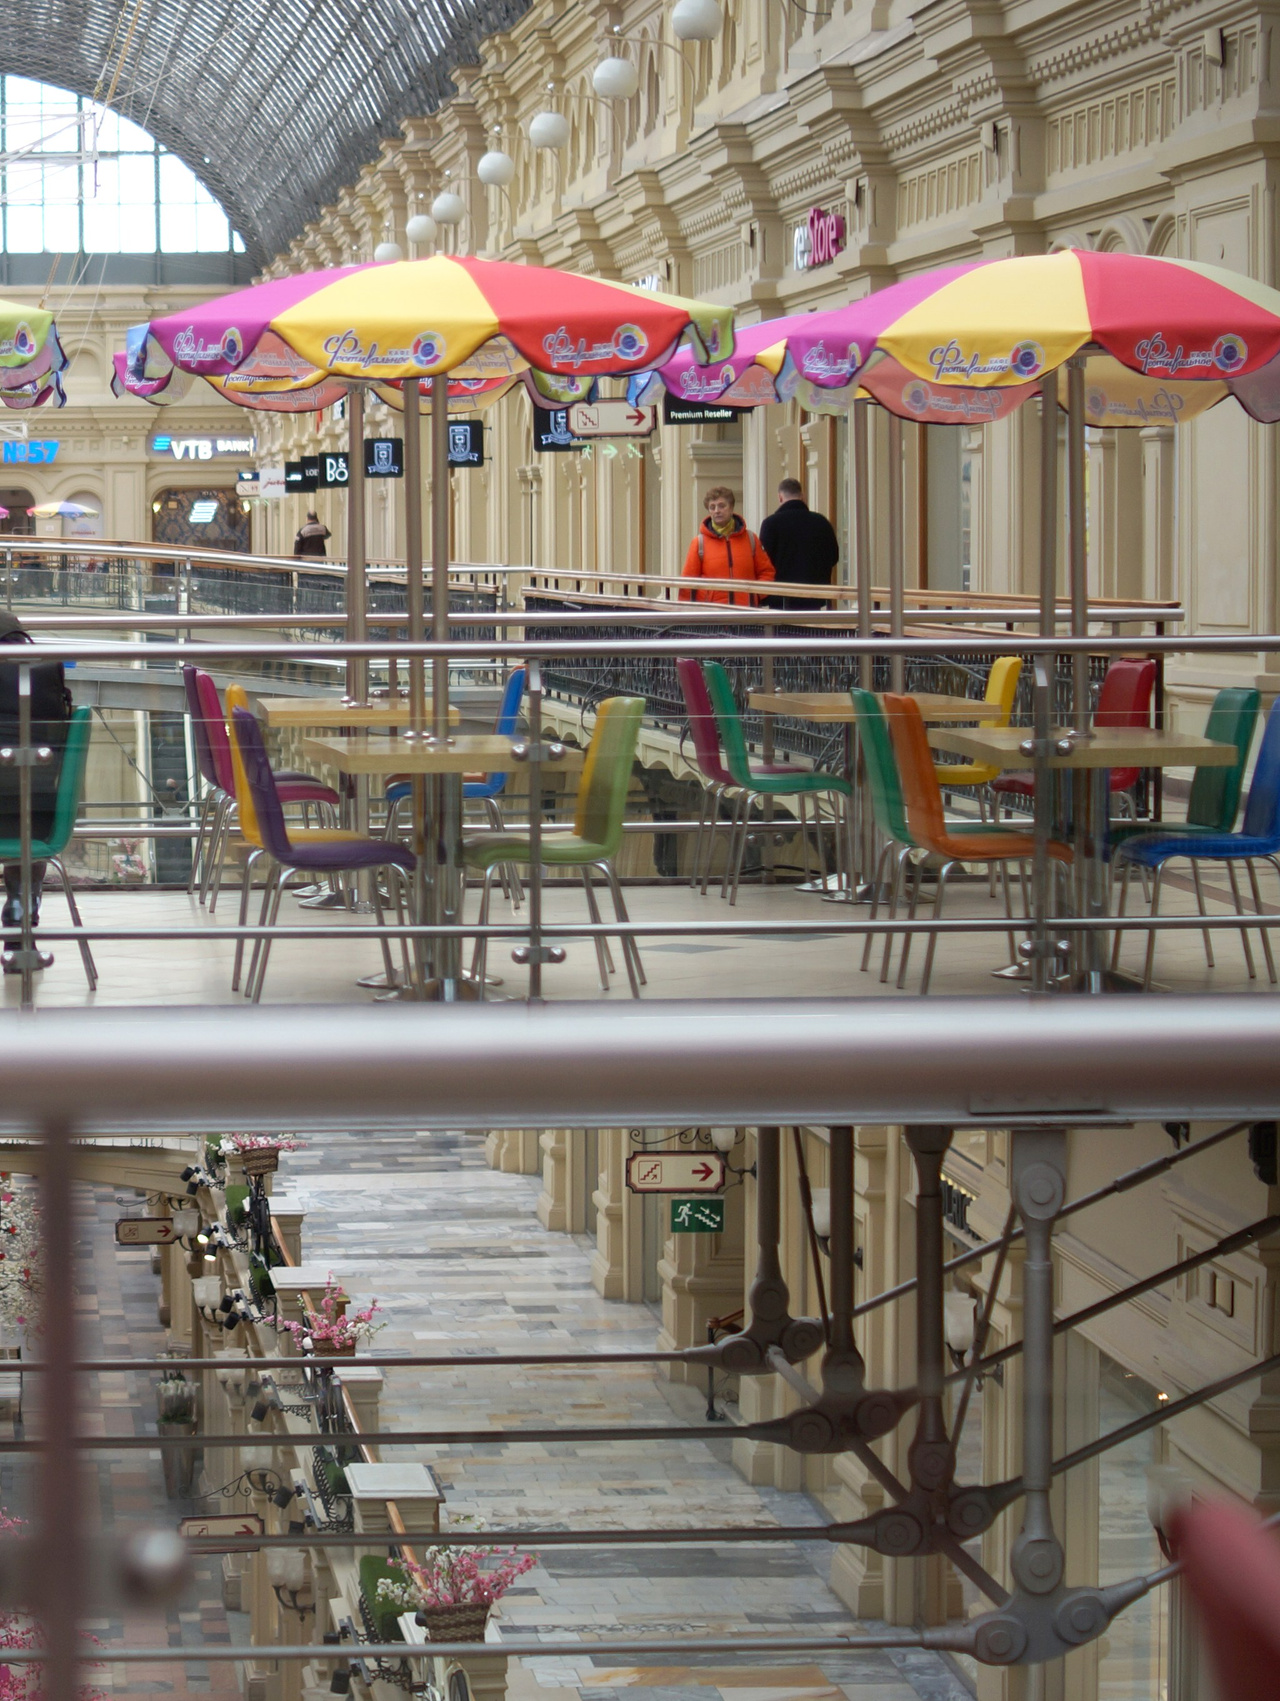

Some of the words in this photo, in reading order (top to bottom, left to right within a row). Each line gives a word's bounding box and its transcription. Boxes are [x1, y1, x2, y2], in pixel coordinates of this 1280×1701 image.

[670, 410, 703, 419] Premium
[704, 409, 732, 418] Reseller
[3, 440, 60, 464] №57
[171, 440, 213, 460] VTB
[216, 440, 250, 452] BANK
